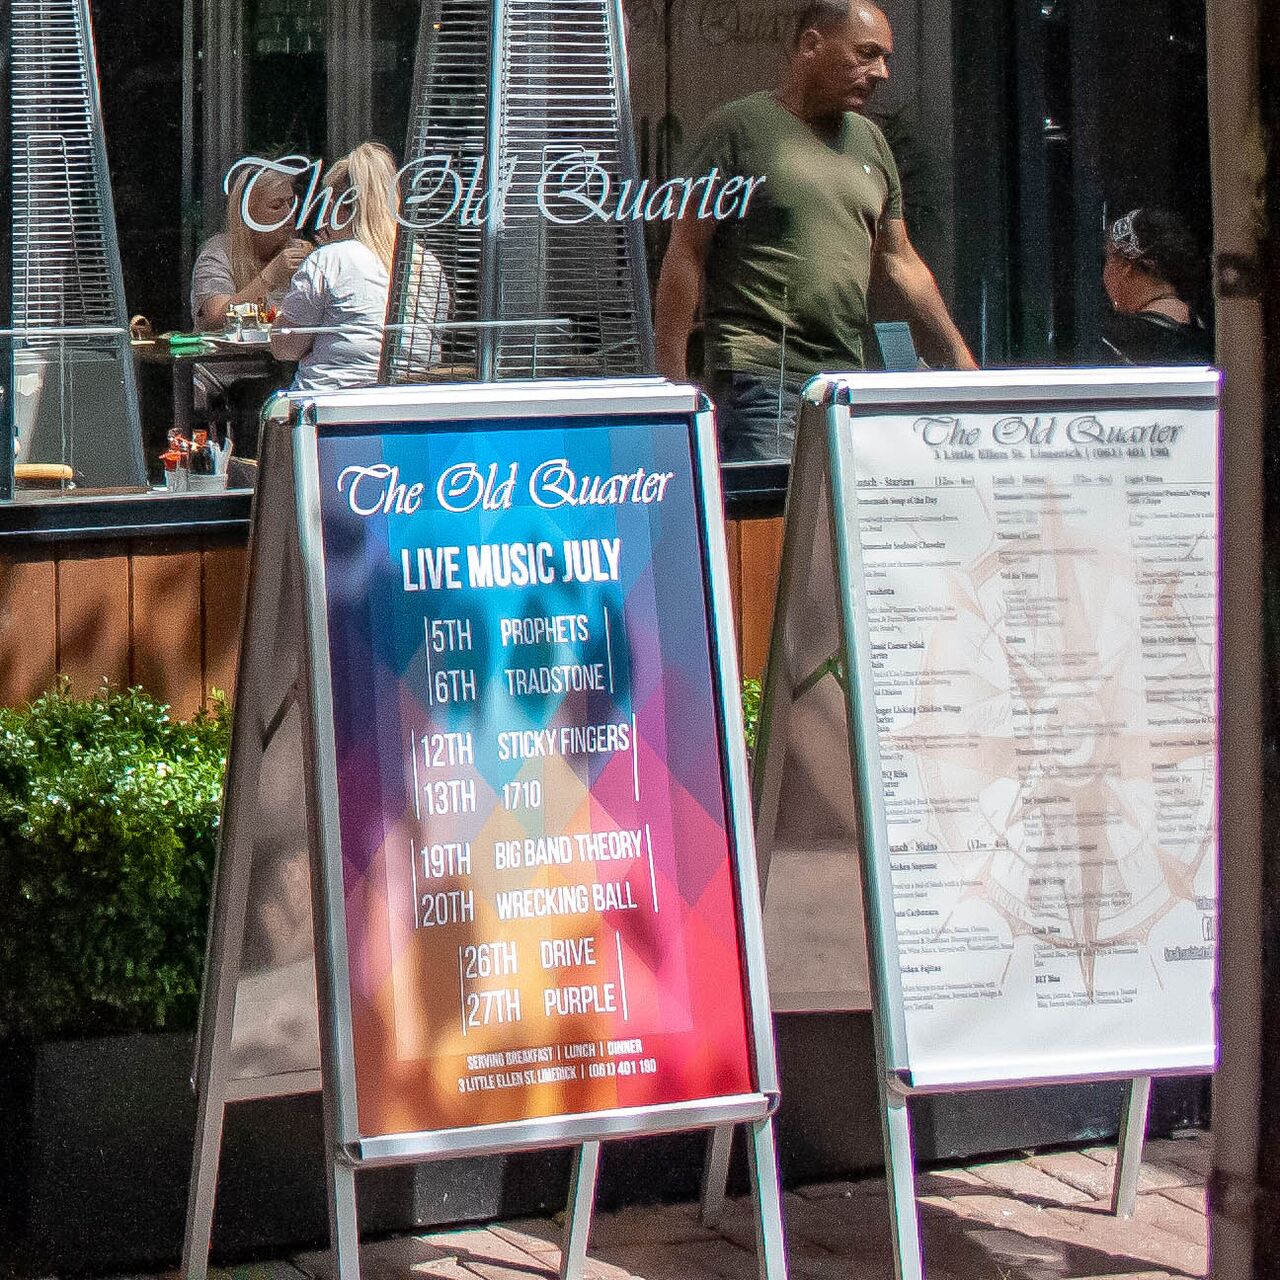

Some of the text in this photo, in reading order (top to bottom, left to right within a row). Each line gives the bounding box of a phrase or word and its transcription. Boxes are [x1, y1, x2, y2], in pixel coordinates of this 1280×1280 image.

[223, 151, 766, 232] The Old Quarter
[913, 415, 1183, 446] The Old Quarter
[337, 458, 674, 516] The Old Quarter
[401, 537, 621, 592] LIVE MUSIC JULY
[431, 614, 589, 653] 5TH PROPHETS
[435, 663, 605, 703] 6TH TRADSTONE
[421, 723, 630, 768] 12TH STICKY FINGERS
[423, 779, 541, 816] 13TH 1710
[420, 829, 642, 879] 19TH BIG BAND THEORY
[421, 881, 638, 927] 20TH WRECKING BALL
[464, 937, 596, 979] 26TH DRIVE
[466, 983, 617, 1026] 27TH PURPLE
[466, 1038, 642, 1070] SERVING BREAKFAST LUNCH DINNER
[465, 1075, 495, 1091] LITTLE
[496, 1072, 523, 1087] ELLEN
[537, 1066, 577, 1083] LIMERICK
[617, 1060, 636, 1075] 401
